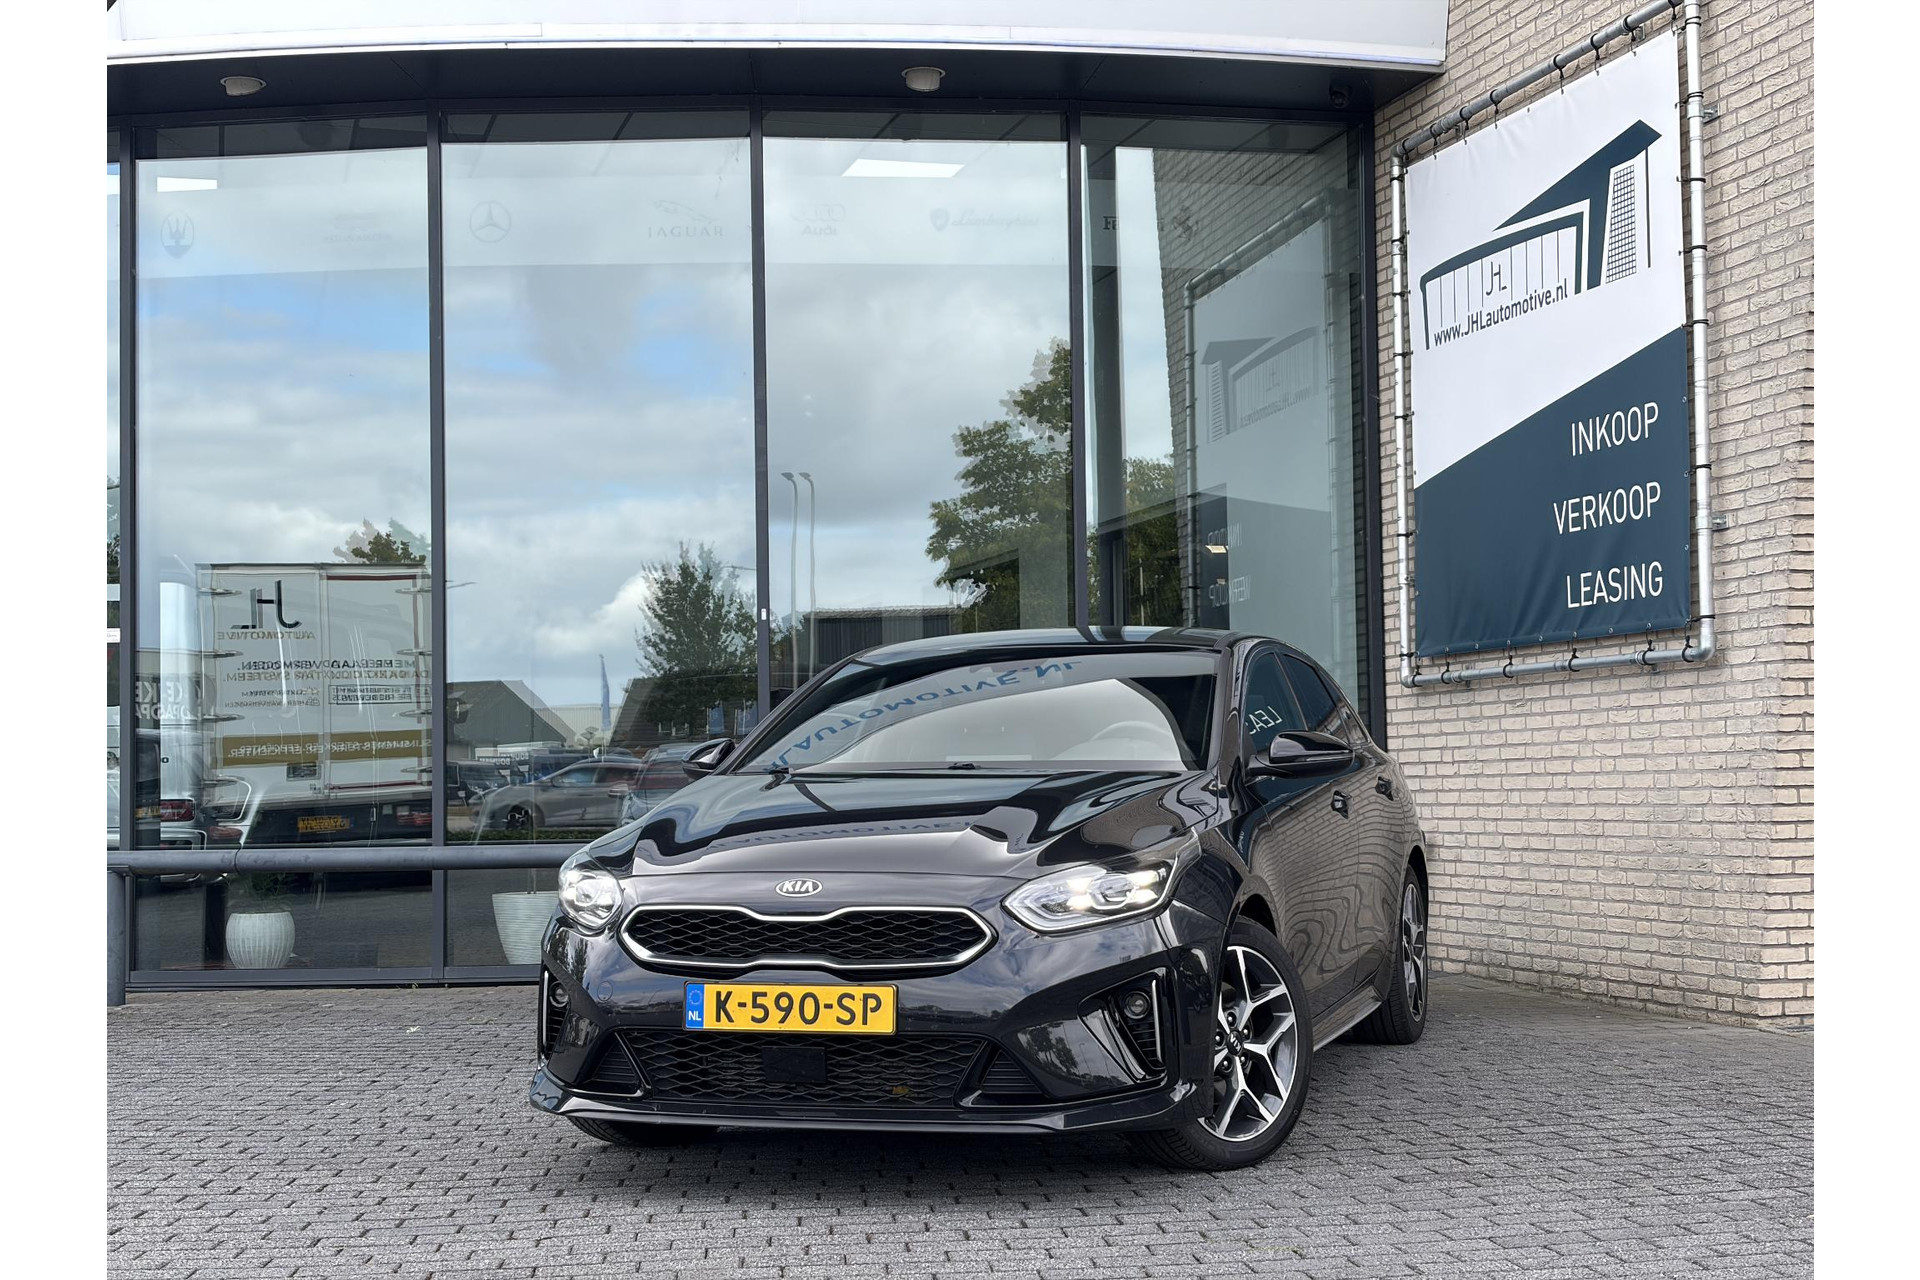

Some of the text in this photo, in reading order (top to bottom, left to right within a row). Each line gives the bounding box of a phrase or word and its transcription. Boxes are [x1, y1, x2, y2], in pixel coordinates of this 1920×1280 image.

[648, 225, 723, 238] JAGUAR
[801, 224, 838, 236] Audi
[1434, 278, 1568, 347] www.JHLautomotive.nl
[1571, 401, 1659, 457] INKOOP
[1553, 481, 1662, 535] VERKOOP
[1566, 561, 1664, 609] LEASING
[782, 880, 813, 892] KIA
[688, 1010, 702, 1021] NL
[715, 990, 882, 1026] K-590-SP
